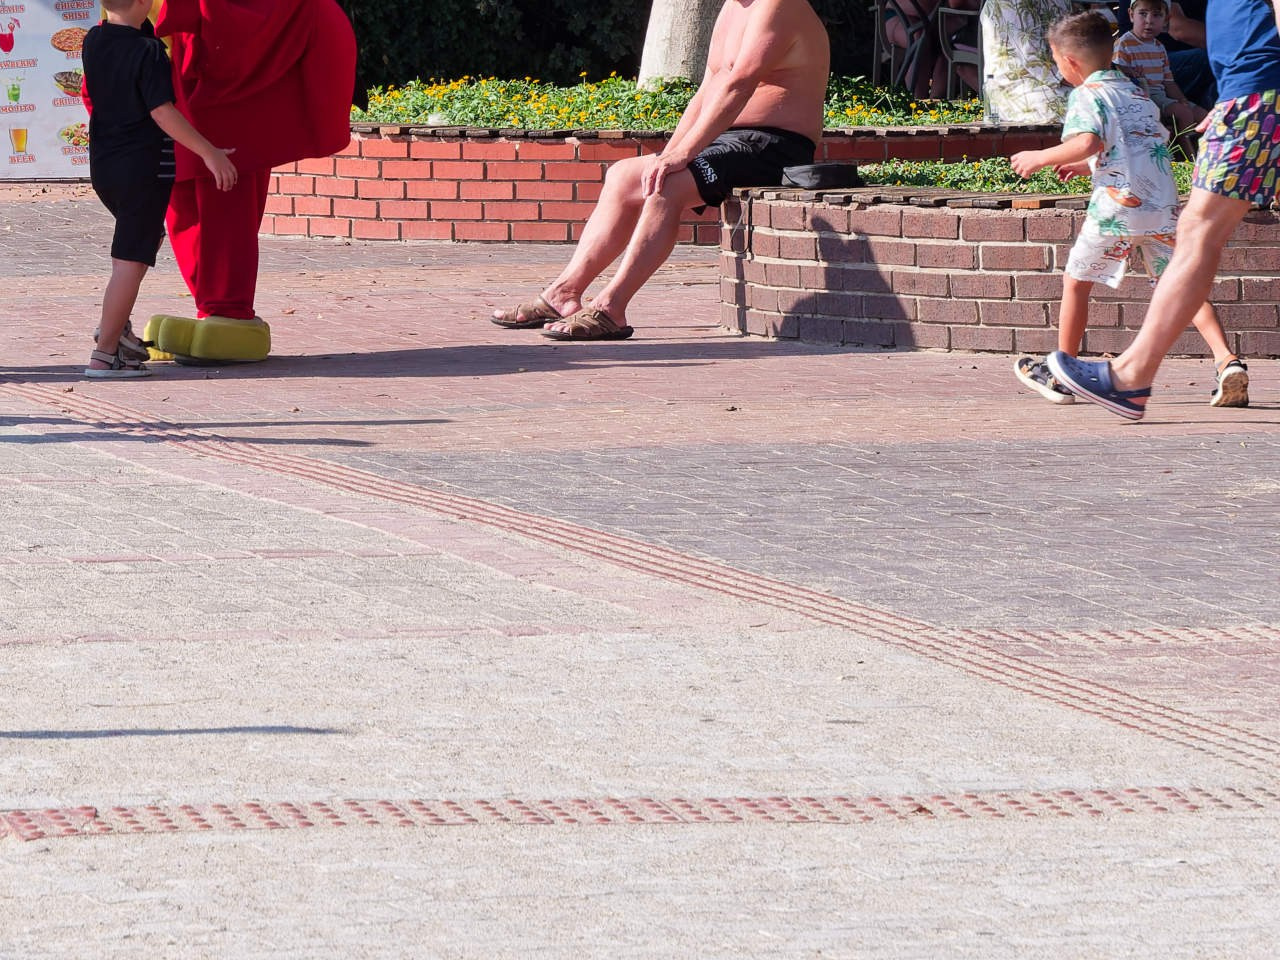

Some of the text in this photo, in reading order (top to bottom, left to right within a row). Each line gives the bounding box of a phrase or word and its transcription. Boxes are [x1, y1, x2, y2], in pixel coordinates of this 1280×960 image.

[55, 0, 94, 11] CHICKEN
[62, 11, 90, 21] SHISH
[65, 51, 81, 60] PIZ
[52, 97, 83, 107] GRILLE
[0, 104, 36, 114] MOJITO
[9, 155, 36, 165] BEER
[71, 156, 88, 166] SAL
[696, 158, 717, 182] BOSS
